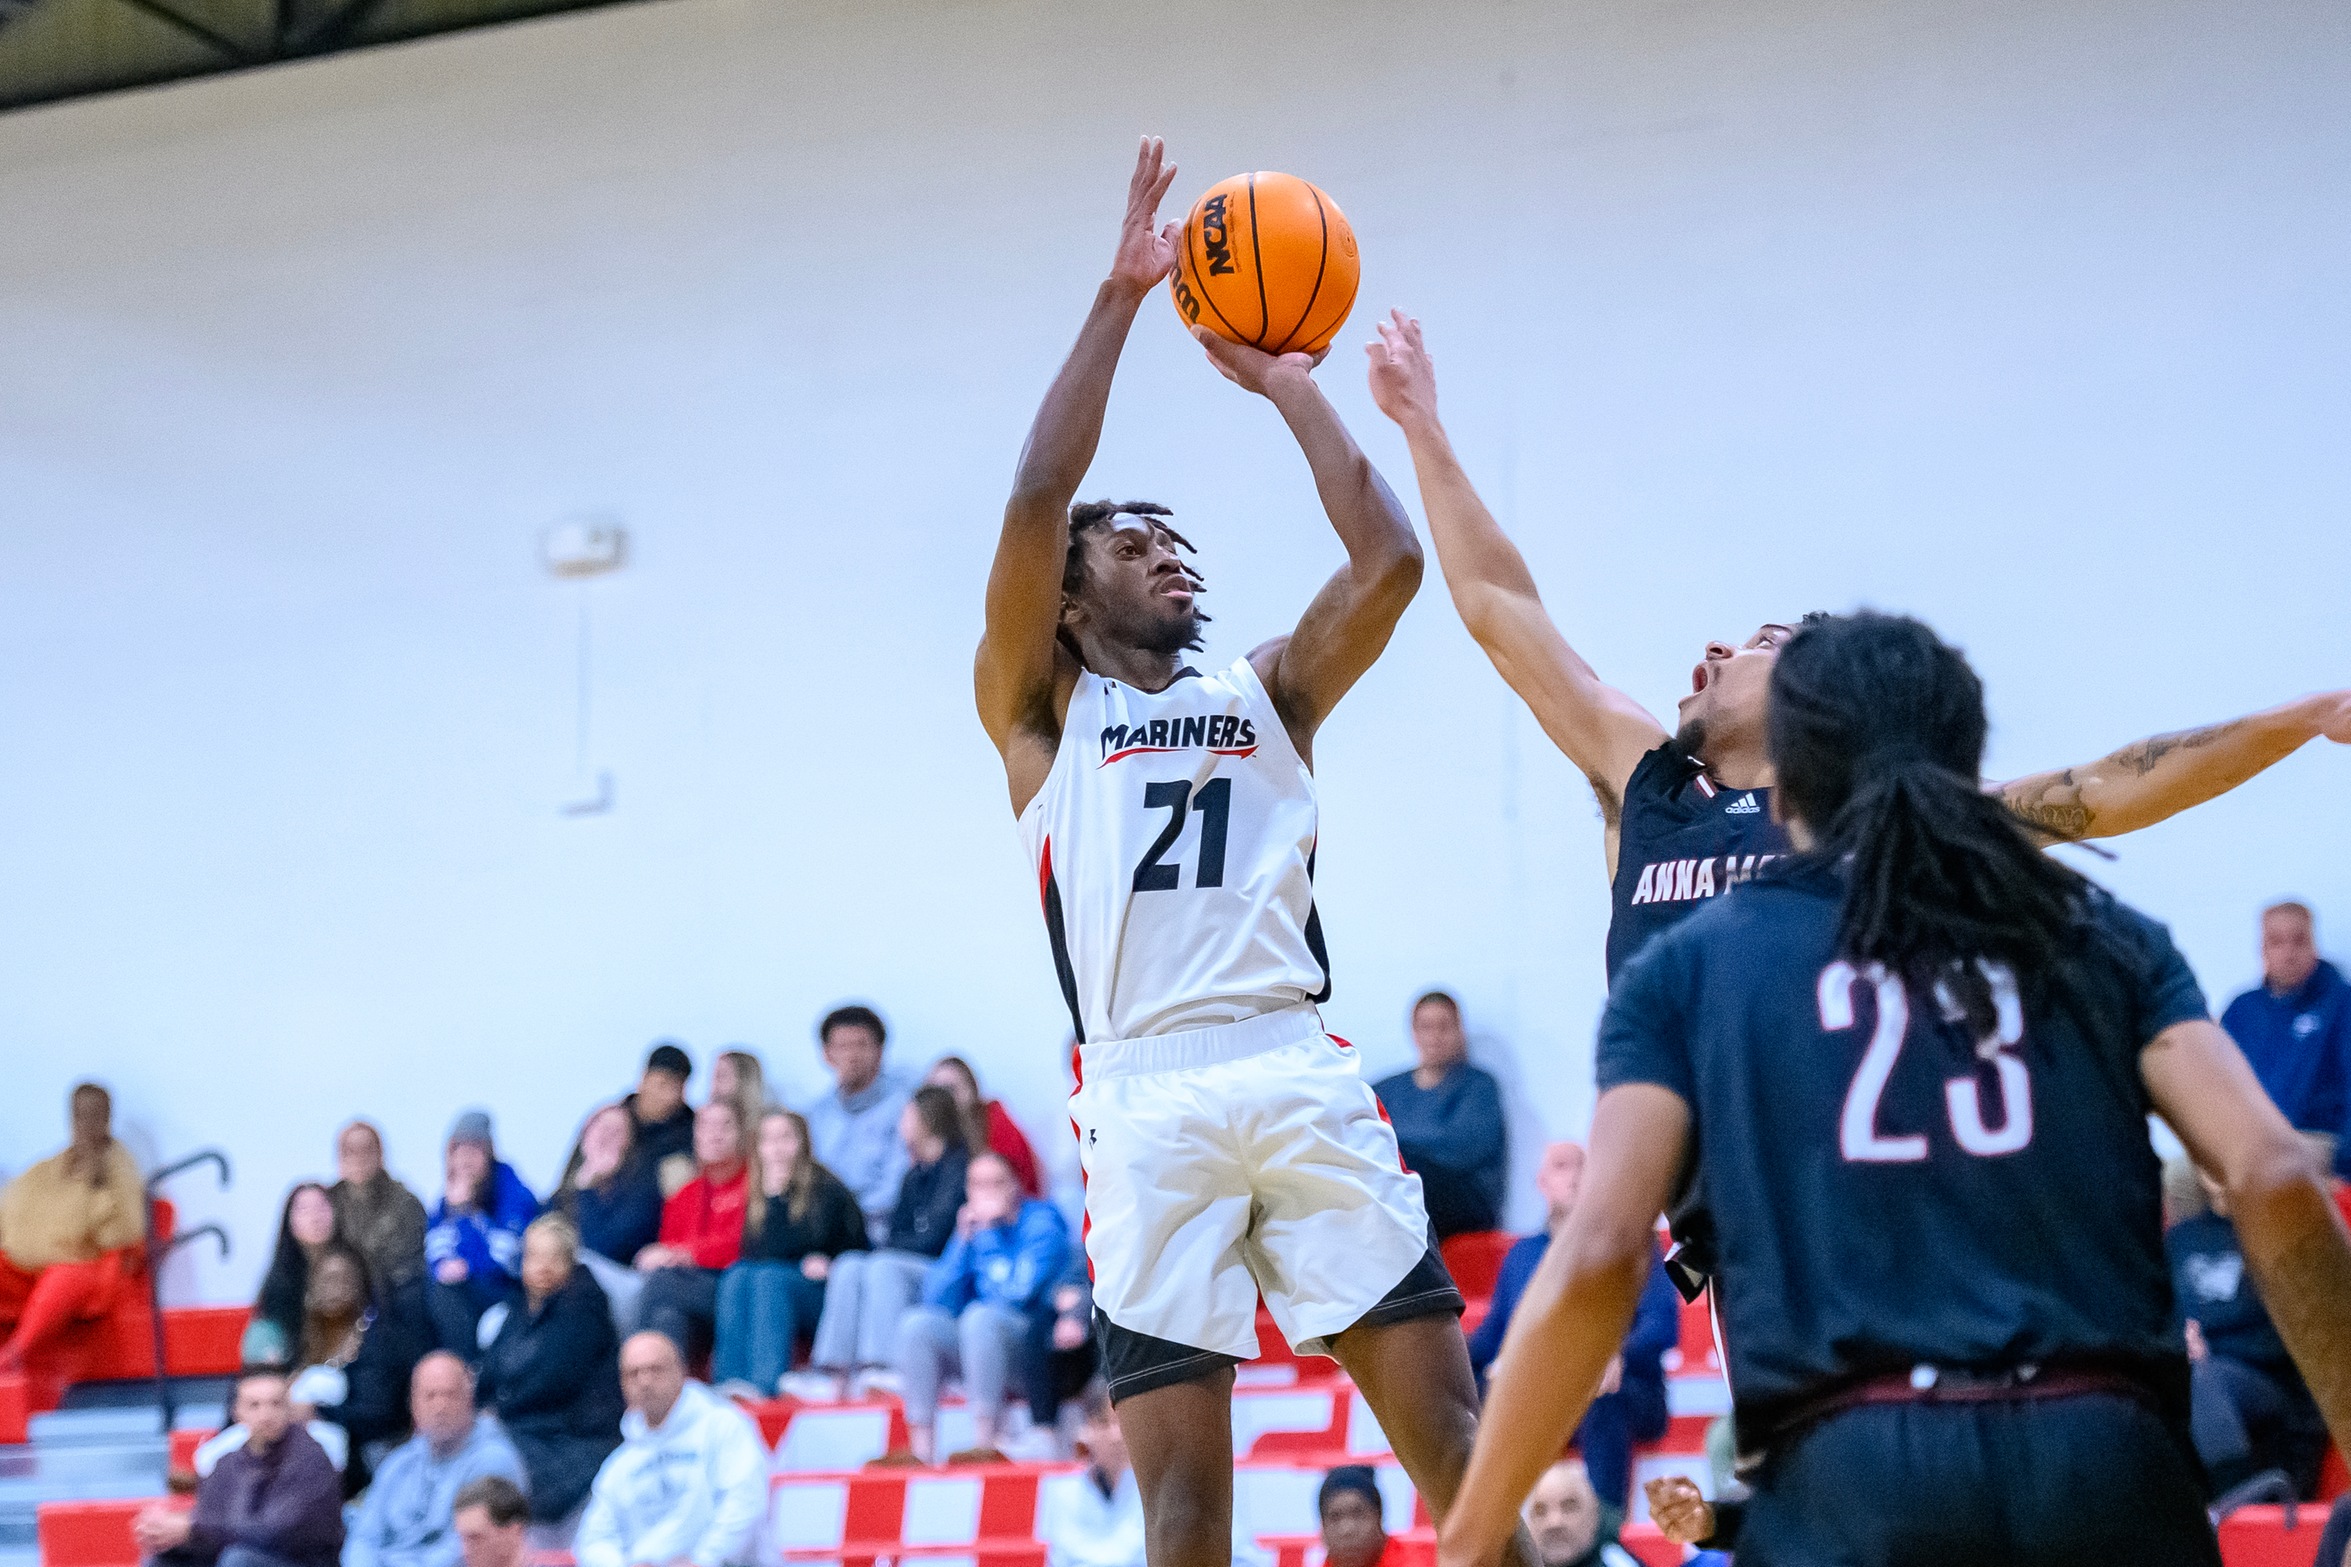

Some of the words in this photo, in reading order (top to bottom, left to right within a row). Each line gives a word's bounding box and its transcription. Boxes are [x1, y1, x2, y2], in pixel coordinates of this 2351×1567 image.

[1204, 194, 1235, 277] NCAA
[1100, 715, 1256, 760] MARINERS
[1132, 777, 1232, 892] 21
[1725, 805, 1760, 814] adidas
[1631, 857, 1717, 905] ANNA
[1816, 958, 2033, 1162] 23
